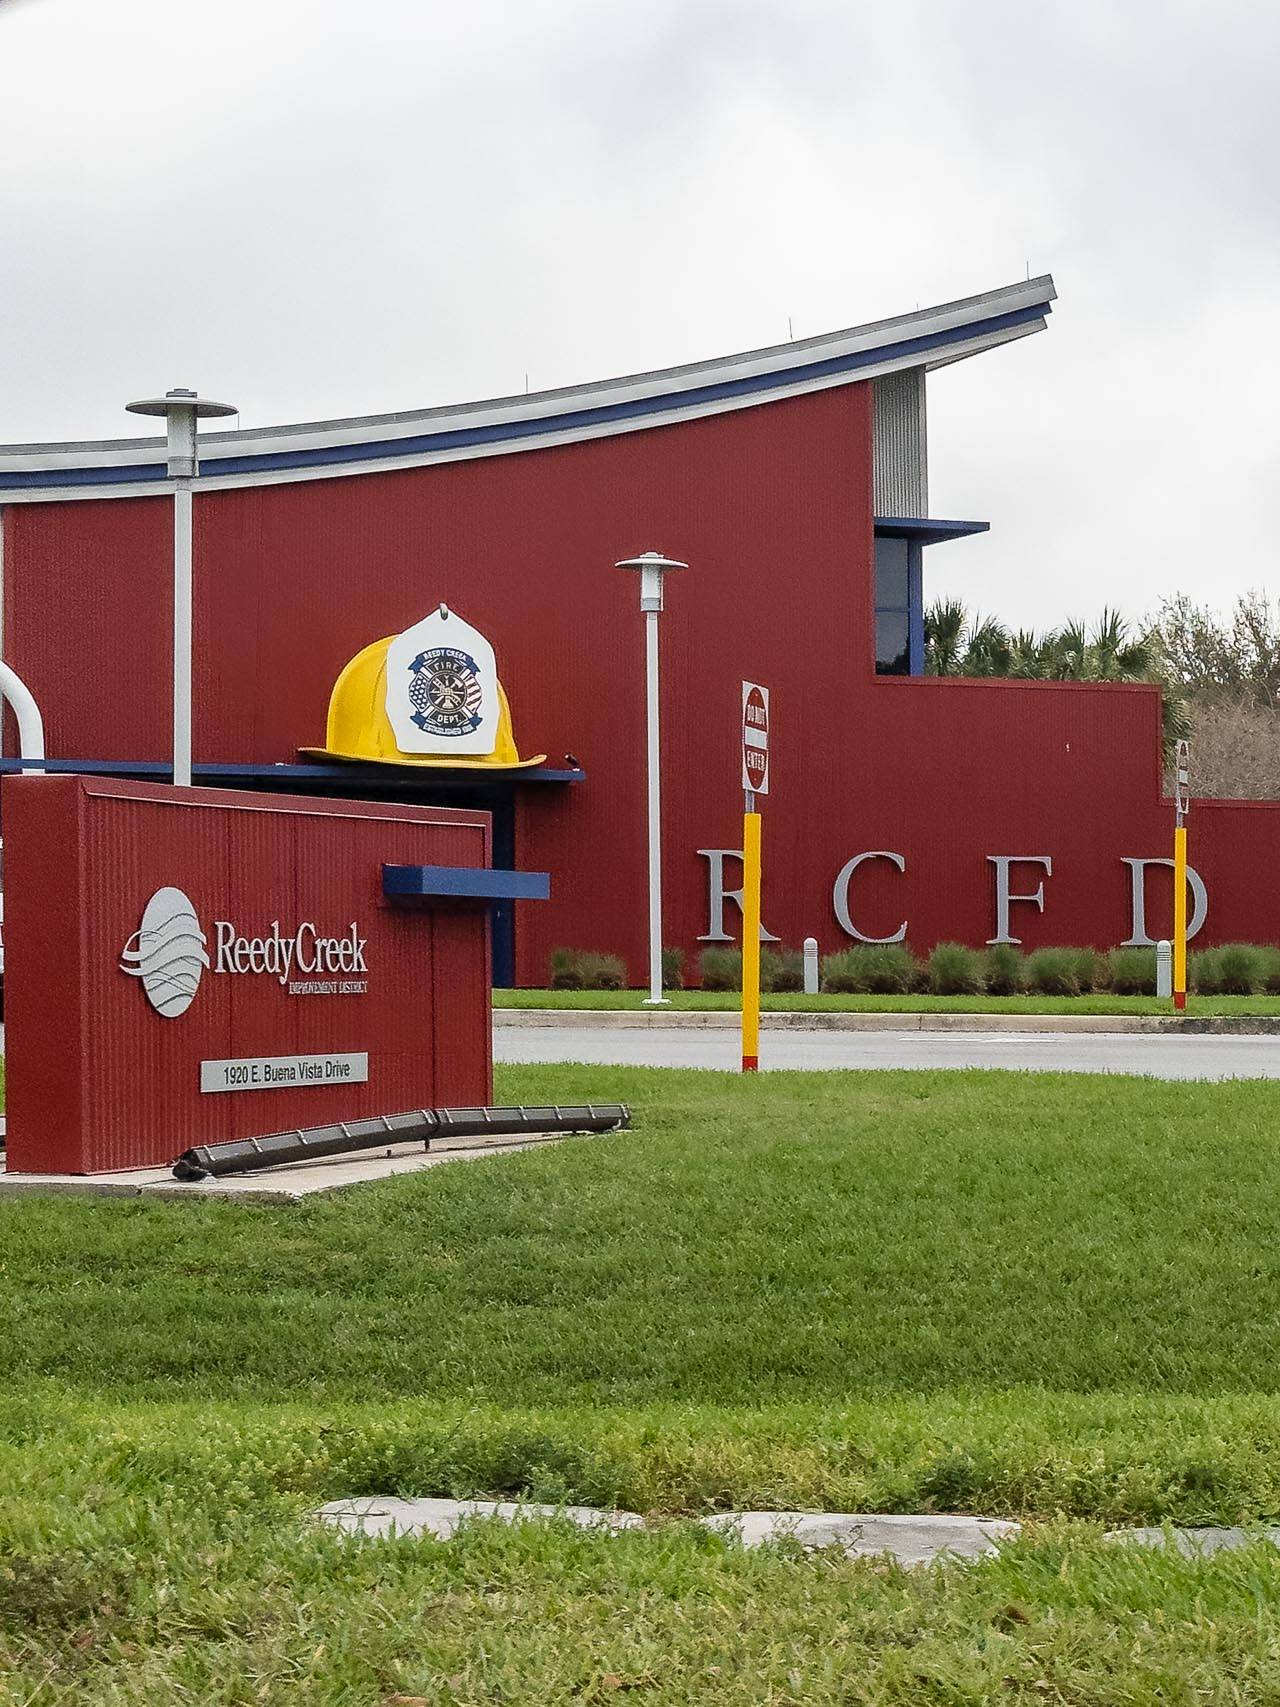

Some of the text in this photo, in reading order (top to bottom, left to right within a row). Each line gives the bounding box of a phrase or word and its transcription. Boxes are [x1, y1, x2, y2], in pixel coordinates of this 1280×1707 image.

[433, 661, 460, 671] FIRE
[747, 750, 766, 772] ENTER
[223, 1060, 351, 1085] 1920 E. Buena Vista Drive
